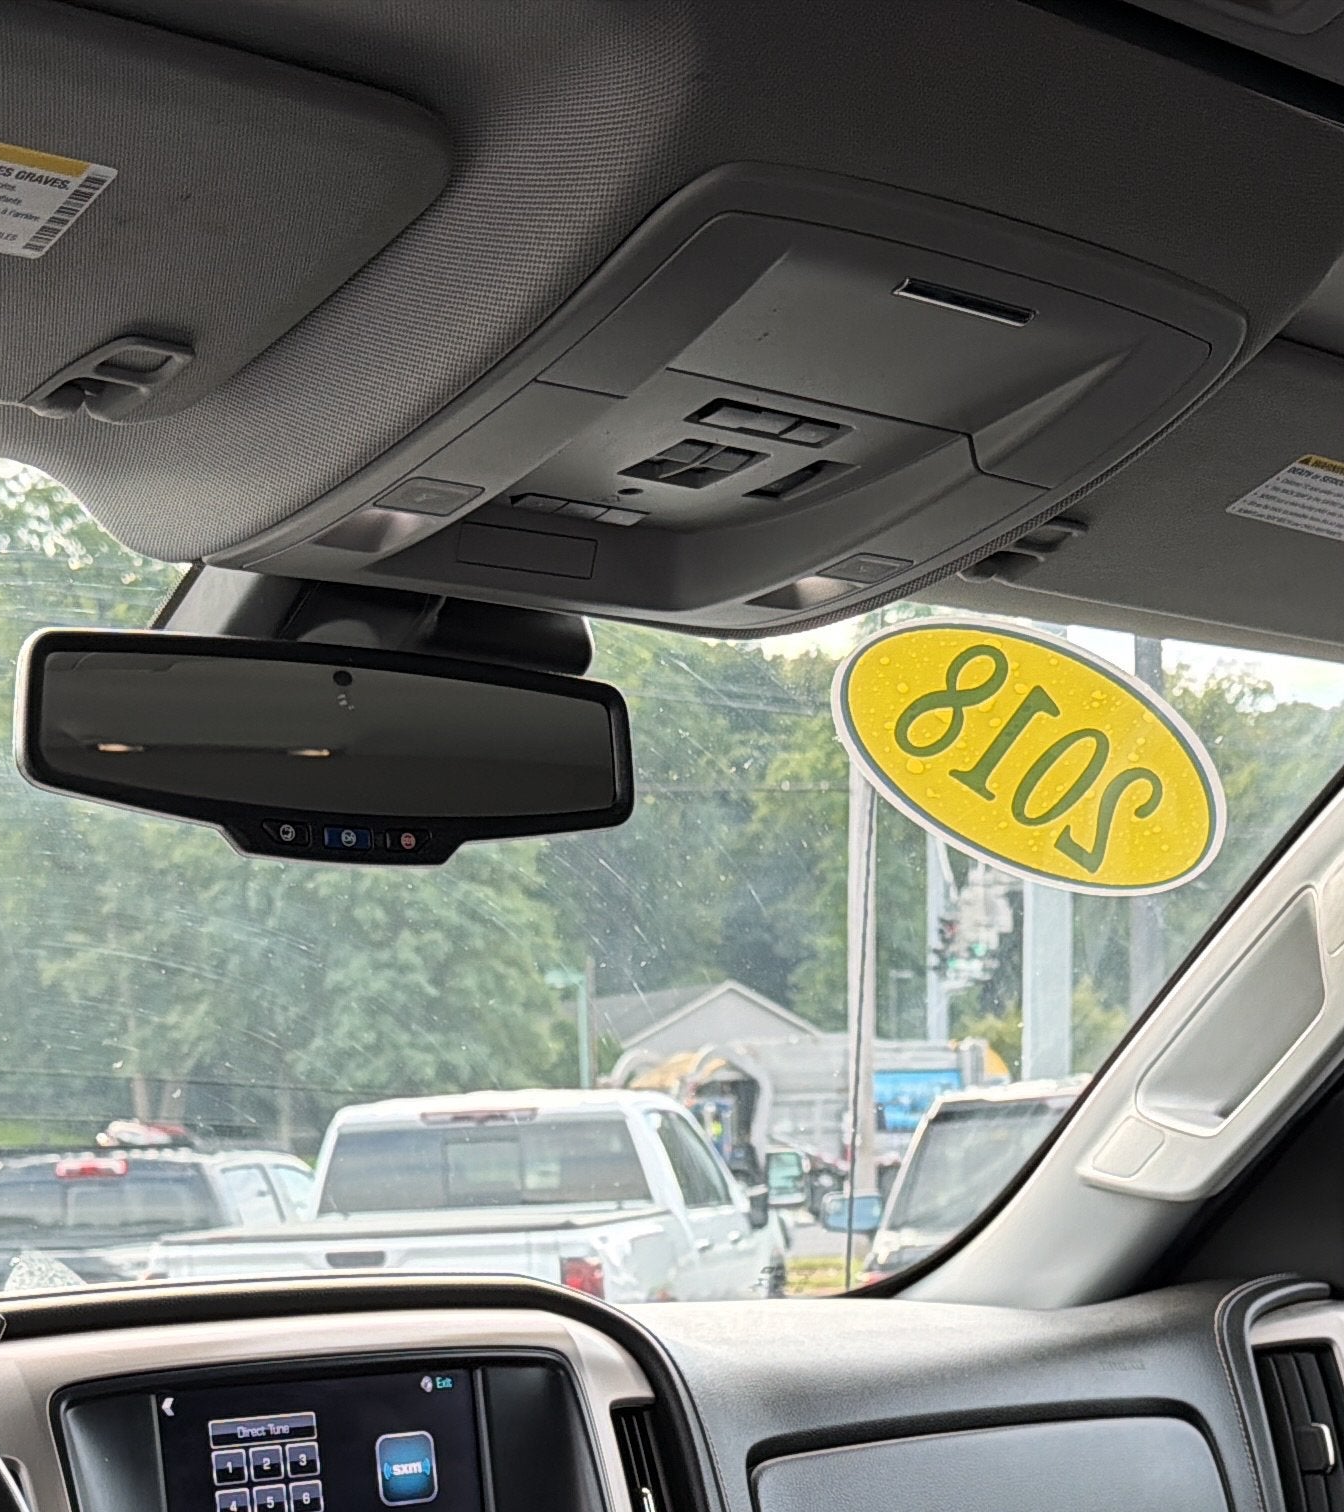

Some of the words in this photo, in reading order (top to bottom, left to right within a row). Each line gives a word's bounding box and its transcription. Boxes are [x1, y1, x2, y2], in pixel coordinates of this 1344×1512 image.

[11, 169, 75, 191] GRAVES.
[1285, 466, 1315, 477] DEATH
[435, 1376, 453, 1389] Exit
[237, 1425, 266, 1439] Direct
[267, 1423, 290, 1436] Tune
[262, 1457, 271, 1470] 2
[298, 1453, 307, 1466] 3
[226, 1461, 233, 1474] 1
[266, 1496, 275, 1509] 5
[302, 1492, 311, 1505] 6
[229, 1500, 238, 1512] 4
